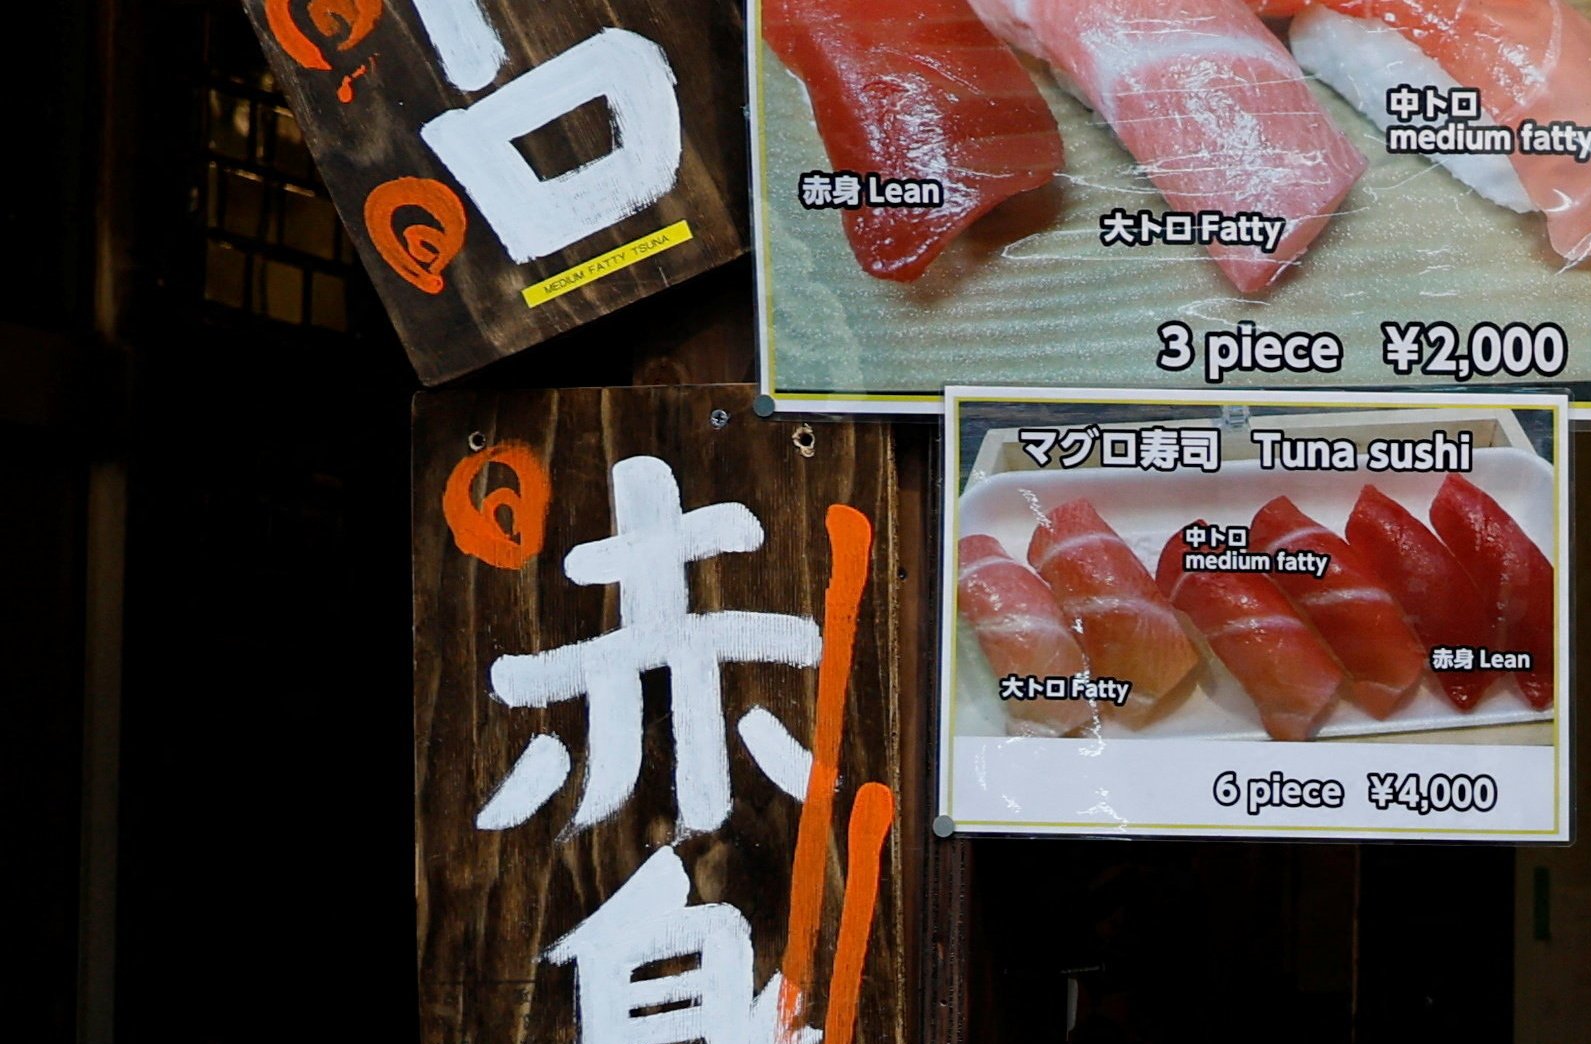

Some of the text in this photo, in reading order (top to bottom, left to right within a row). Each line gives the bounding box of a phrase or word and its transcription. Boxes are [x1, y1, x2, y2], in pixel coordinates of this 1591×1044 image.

[1388, 88, 1479, 120] 中トロ
[1389, 123, 1511, 152] medium
[802, 175, 941, 206] 赤身 Lean
[1101, 212, 1285, 250] 大トロ Fatty
[543, 234, 670, 293] MEDIUM FATTY TSUNA
[1159, 324, 1565, 379] 3 piece ¥2,000
[1018, 428, 1472, 471] マグロ寿司 Tuna sushi
[1185, 527, 1247, 548] 中トロ
[1185, 550, 1328, 576] medium fatty
[1432, 647, 1530, 669] 赤身 Lean
[1001, 677, 1129, 704] 大トロ Fatty
[1214, 773, 1497, 812] 6 piece ¥4,000
